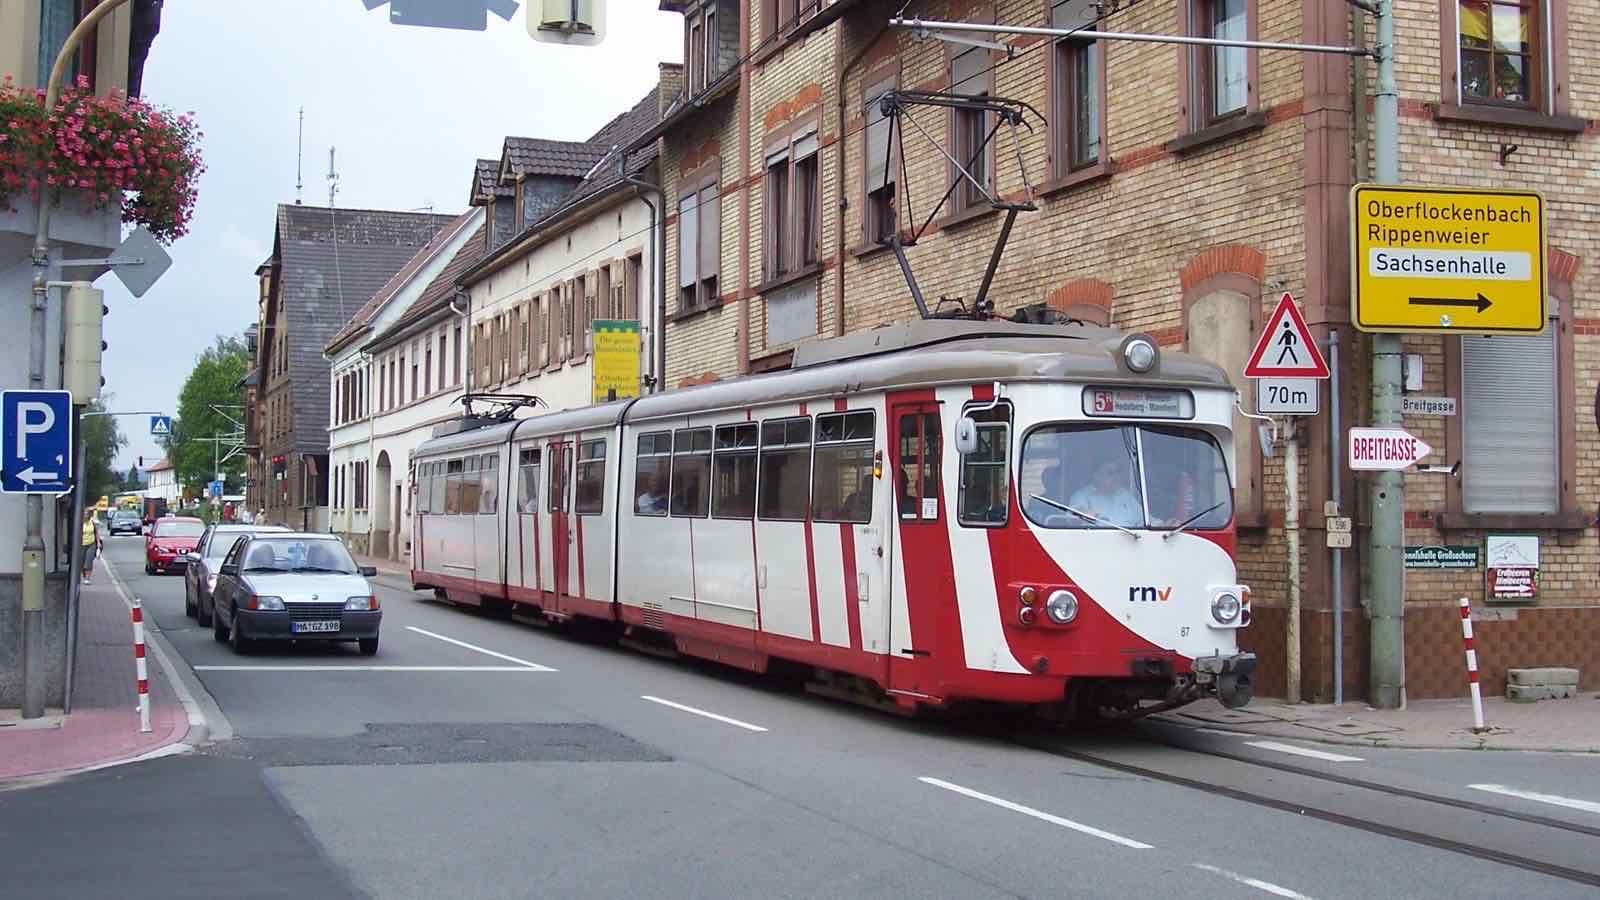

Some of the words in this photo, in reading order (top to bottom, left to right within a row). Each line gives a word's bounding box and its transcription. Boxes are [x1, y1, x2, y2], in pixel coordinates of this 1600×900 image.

[1367, 199, 1531, 223] Oberflockenbach
[1367, 223, 1490, 246] Rippenweier
[1375, 252, 1507, 275] Sachsenhalle
[1402, 398, 1455, 413] Breitgasse
[16, 401, 56, 459] P
[1353, 437, 1417, 461] BREITGASSE
[1496, 568, 1530, 577] Erdbeeren
[1128, 586, 1172, 602] rnv
